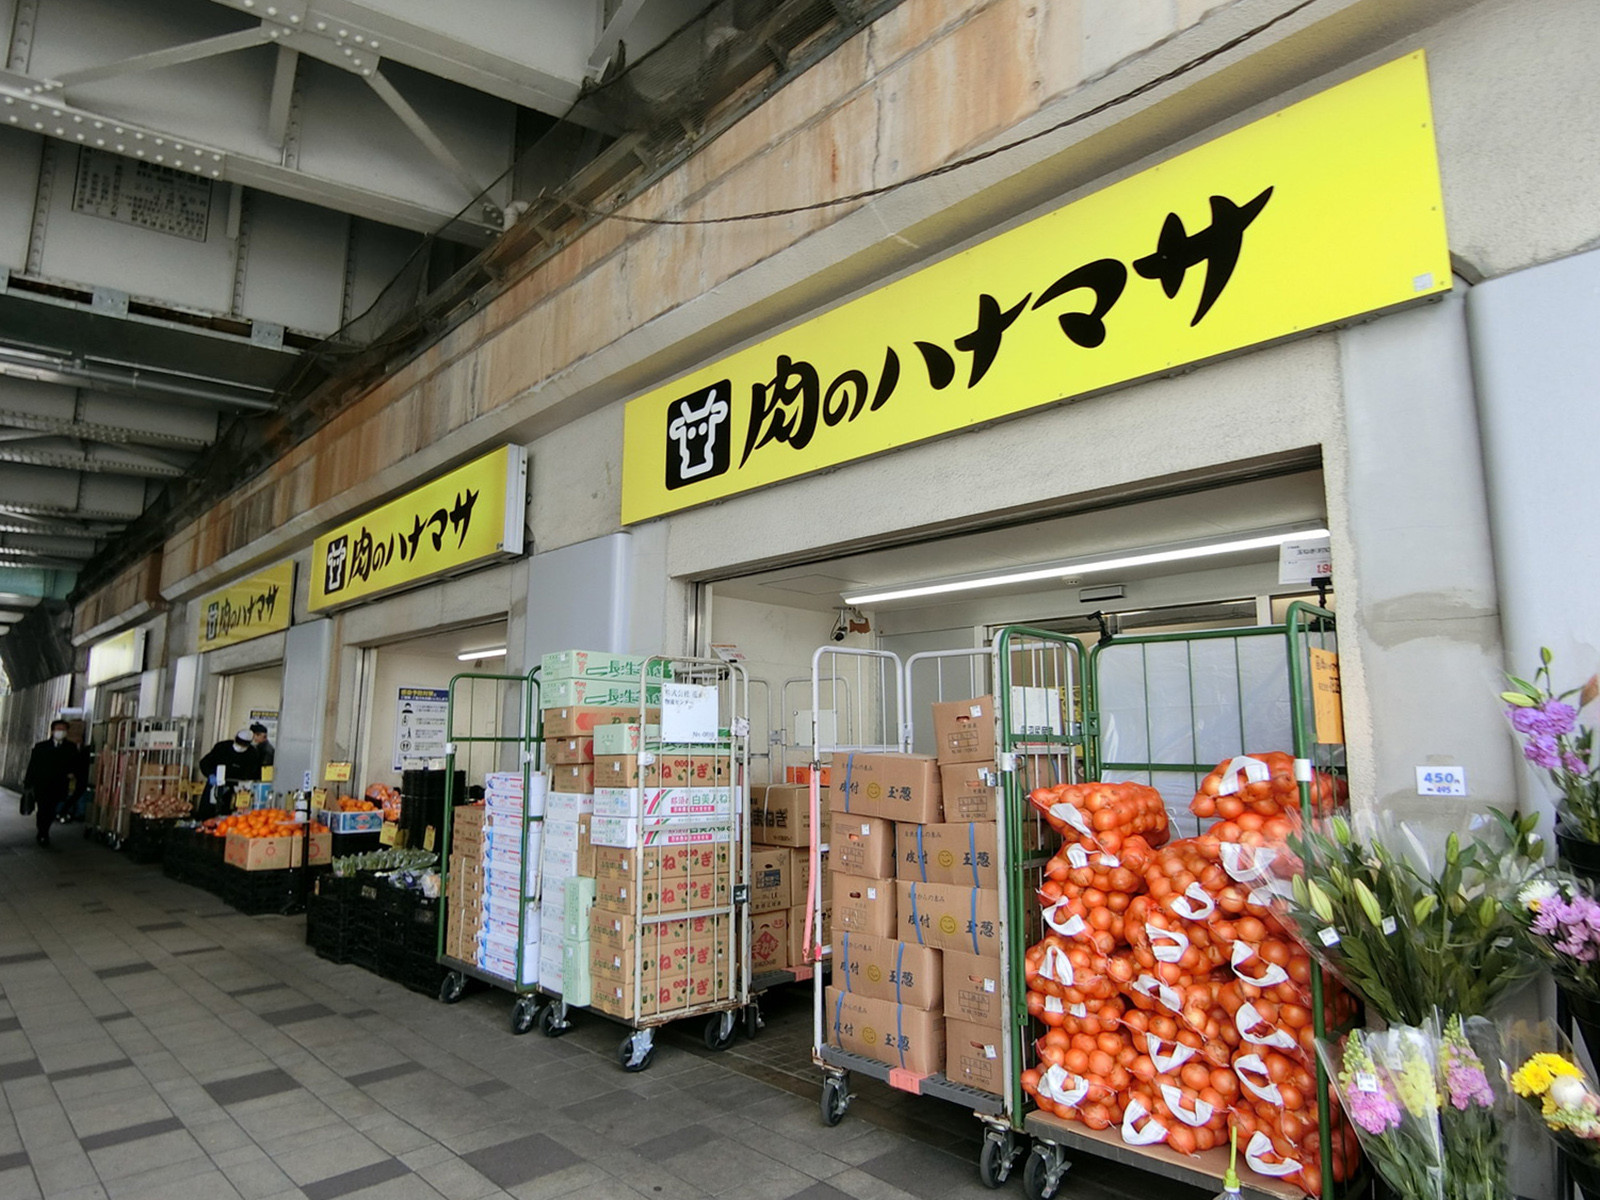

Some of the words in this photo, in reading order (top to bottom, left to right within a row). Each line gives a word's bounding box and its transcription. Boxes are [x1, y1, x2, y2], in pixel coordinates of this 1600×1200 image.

[739, 184, 1276, 470] 肉のハナマサ
[346, 488, 480, 588] 肉のハナマサ
[219, 584, 280, 636] 肉のハナマサ
[692, 793, 734, 805] 白美人ね
[887, 785, 912, 802] 玉葱
[965, 919, 995, 938] 玉葱
[888, 969, 914, 988] 玉葱
